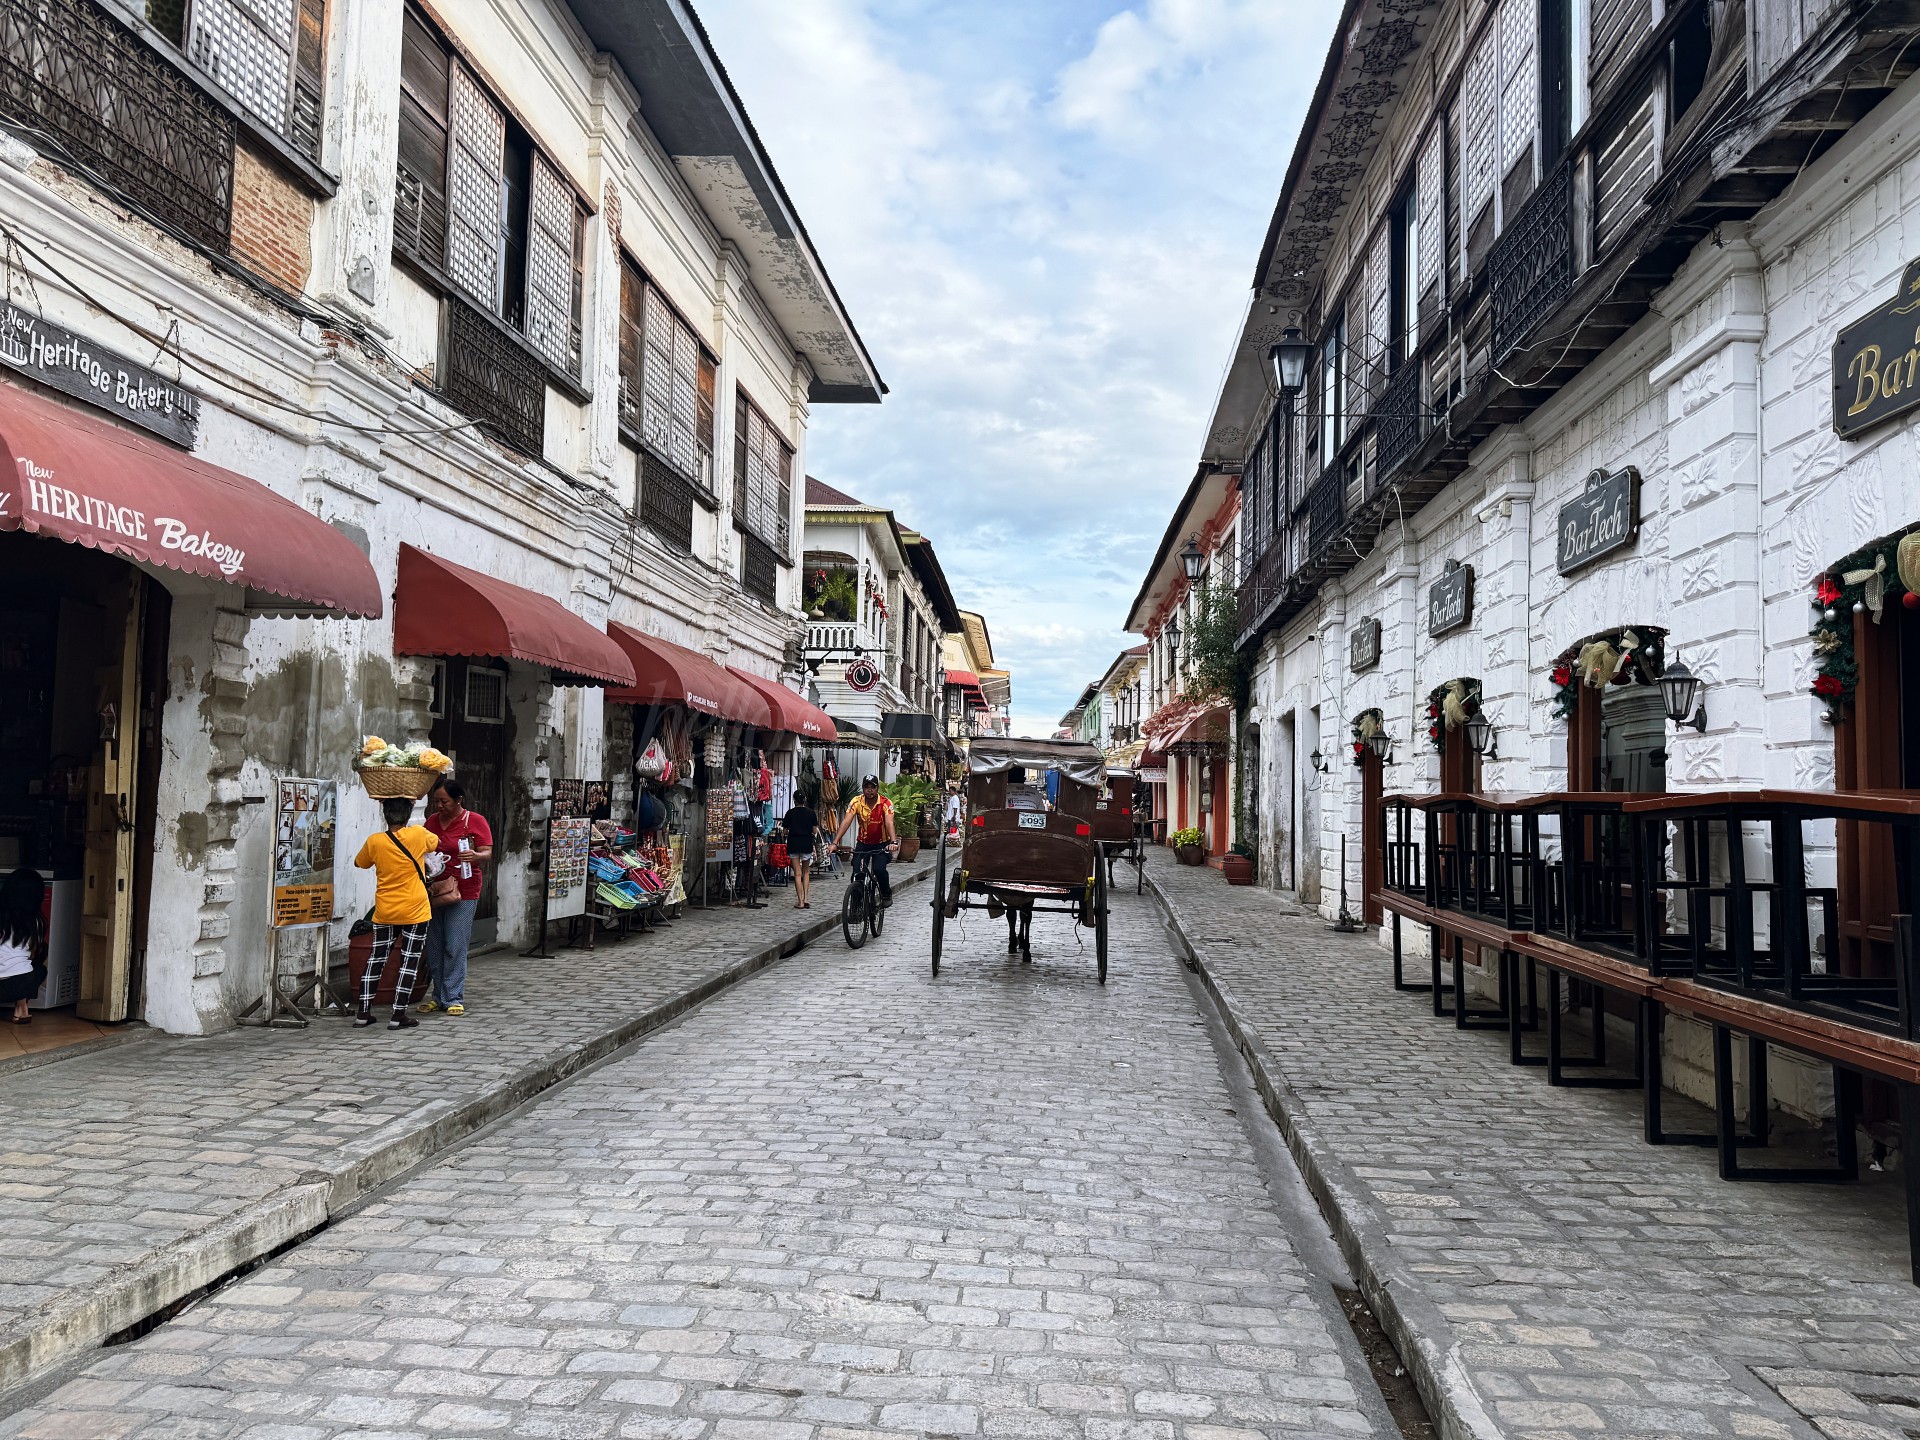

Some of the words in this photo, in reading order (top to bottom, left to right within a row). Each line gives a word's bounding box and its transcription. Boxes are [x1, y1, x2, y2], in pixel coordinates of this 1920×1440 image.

[7, 307, 35, 335] New
[30, 330, 110, 393] Heritage
[115, 370, 174, 414] Bakery
[1847, 325, 1920, 417] Bar
[17, 457, 54, 479] New
[28, 478, 147, 541] HERITAGE
[154, 517, 246, 575] Bakery
[1027, 817, 1045, 825] 093
